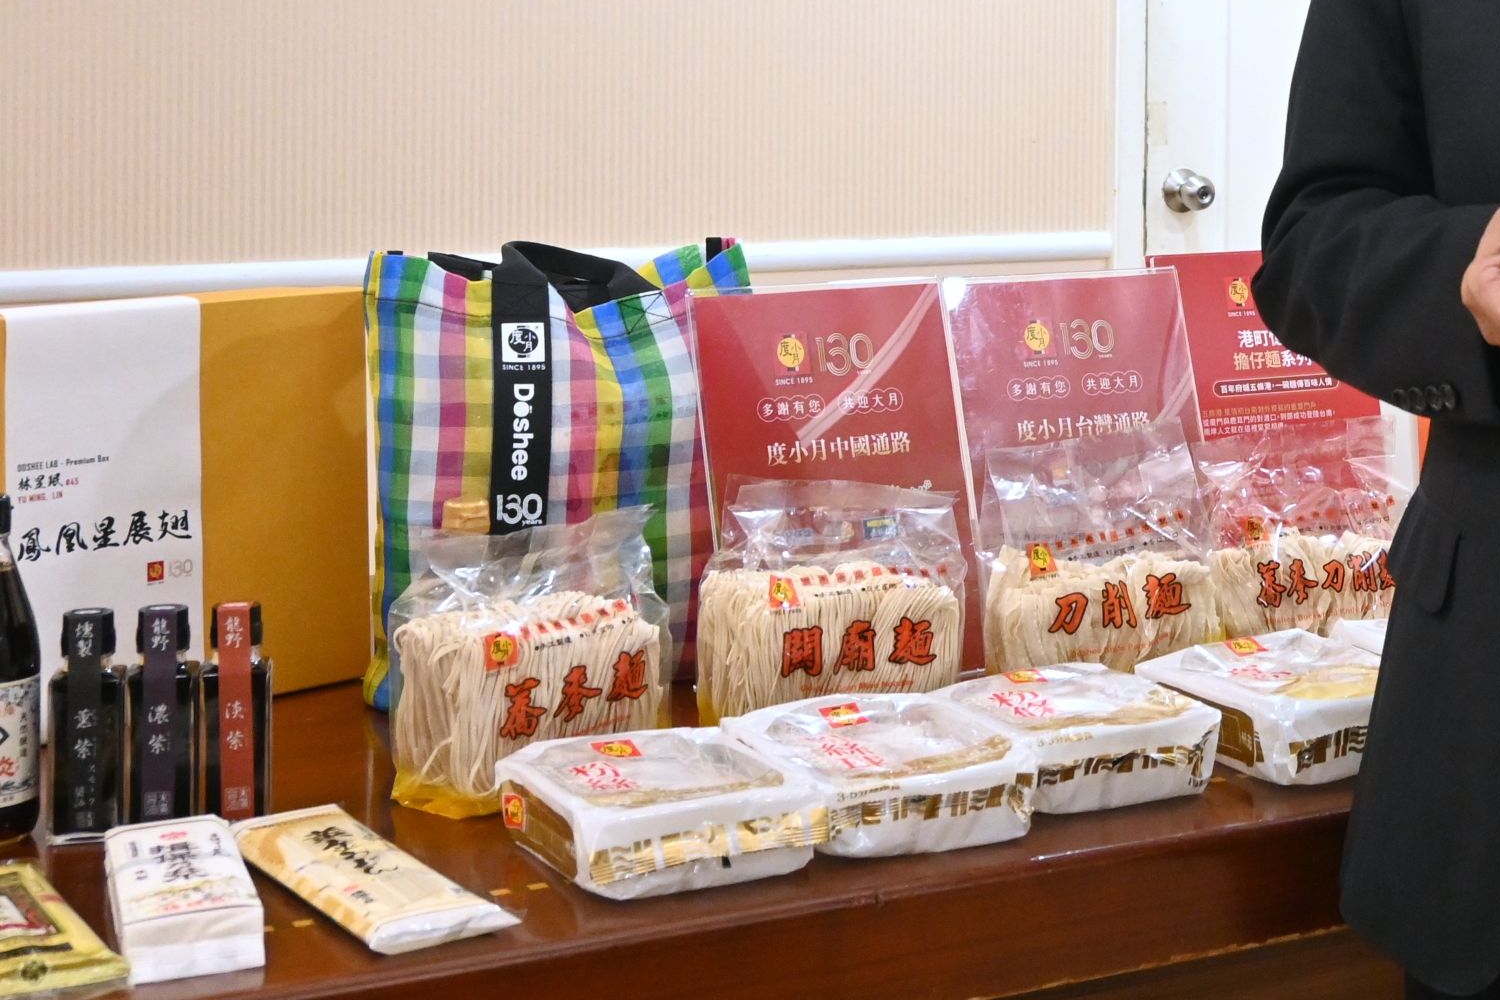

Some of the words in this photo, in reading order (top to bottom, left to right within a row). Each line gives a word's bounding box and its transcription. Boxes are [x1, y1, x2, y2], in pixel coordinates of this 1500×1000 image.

[815, 332, 874, 377] 130
[1059, 318, 1115, 360] 130
[775, 378, 795, 386] SINCE
[797, 376, 813, 384] 1895
[762, 399, 822, 417] 多謝有您
[843, 391, 899, 409] 共迎大月
[45, 459, 58, 469] LAB
[66, 456, 95, 467] Premium
[767, 431, 911, 466] 度小月中國通路
[496, 493, 543, 525] 130
[1048, 572, 1192, 635] 刀削麵
